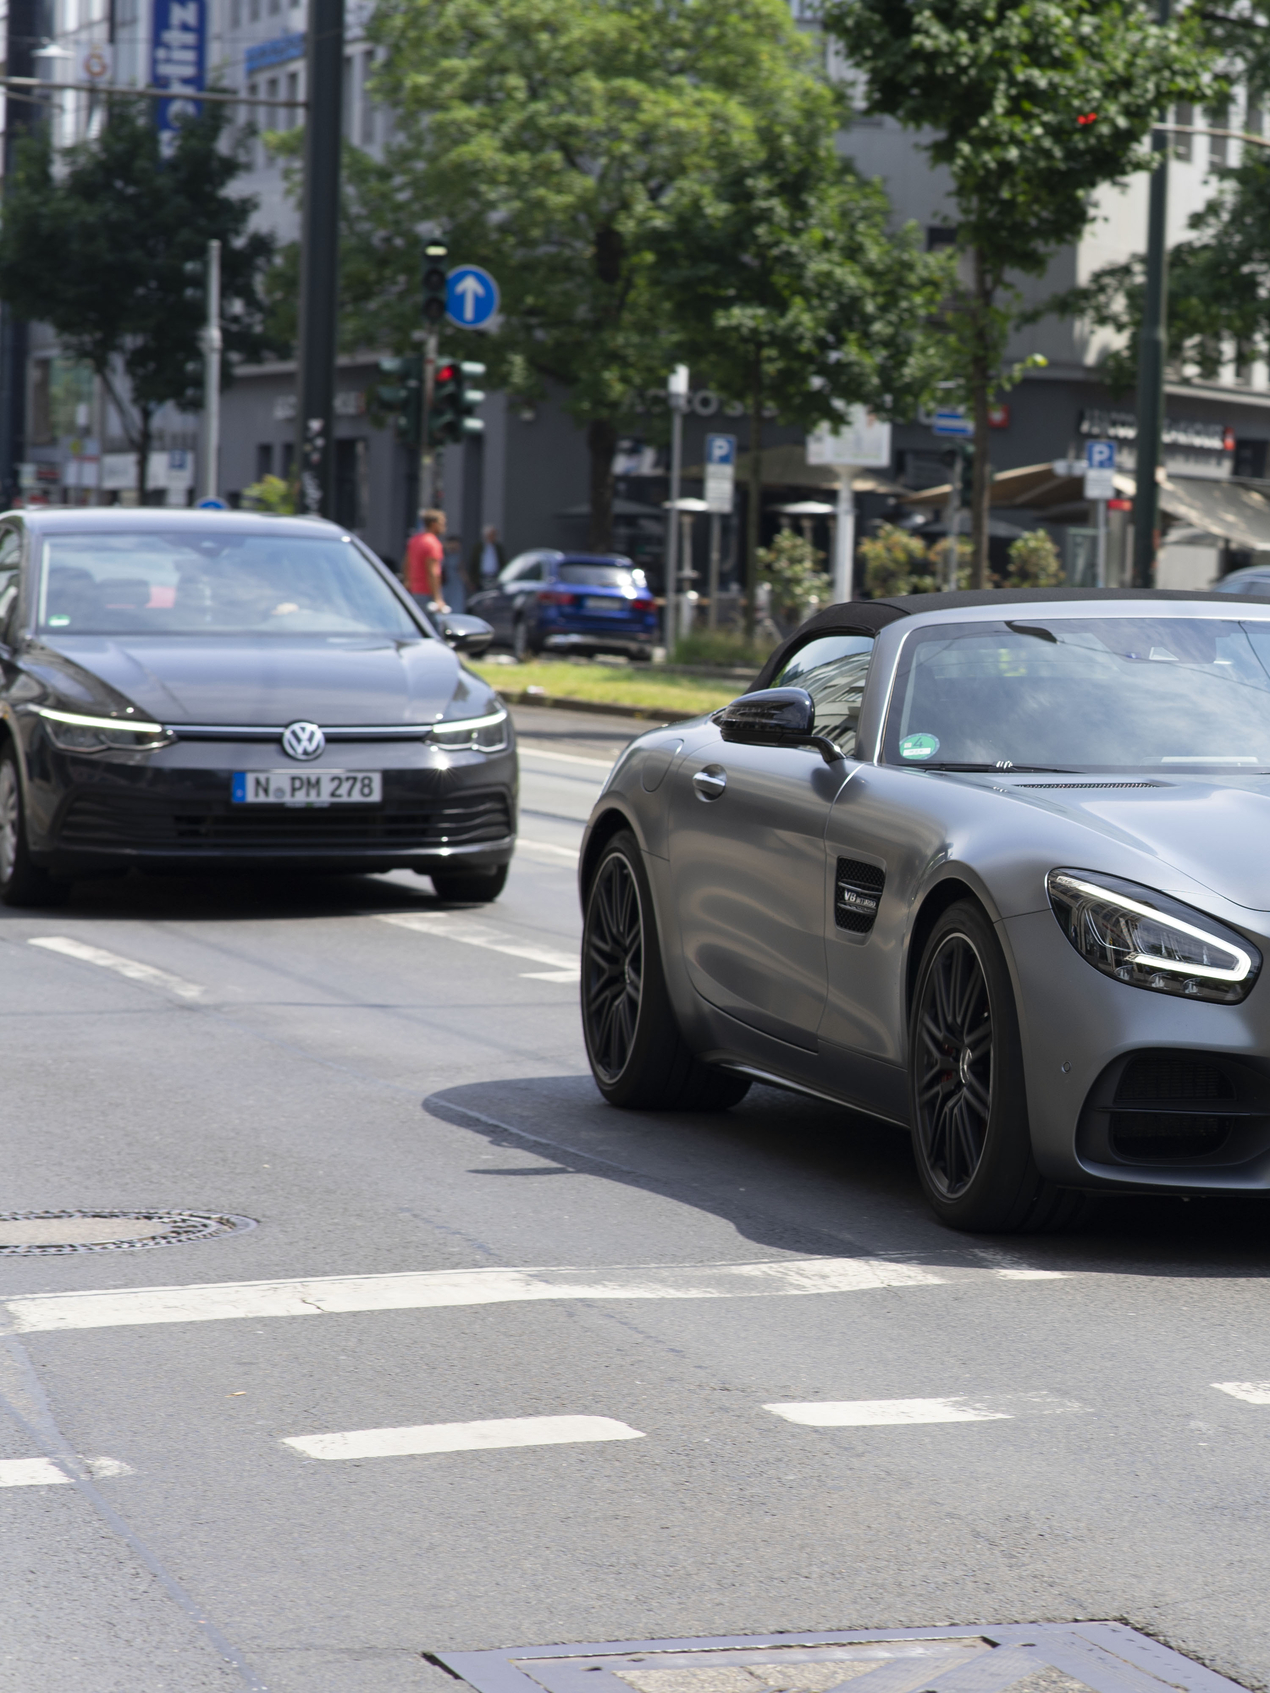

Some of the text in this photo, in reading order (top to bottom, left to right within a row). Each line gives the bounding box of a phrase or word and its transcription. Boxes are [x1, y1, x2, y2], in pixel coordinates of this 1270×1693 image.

[711, 438, 730, 464] P
[1092, 444, 1111, 467] P
[913, 737, 923, 748] 4
[254, 776, 373, 798] N PM 278
[844, 890, 857, 902] V8
